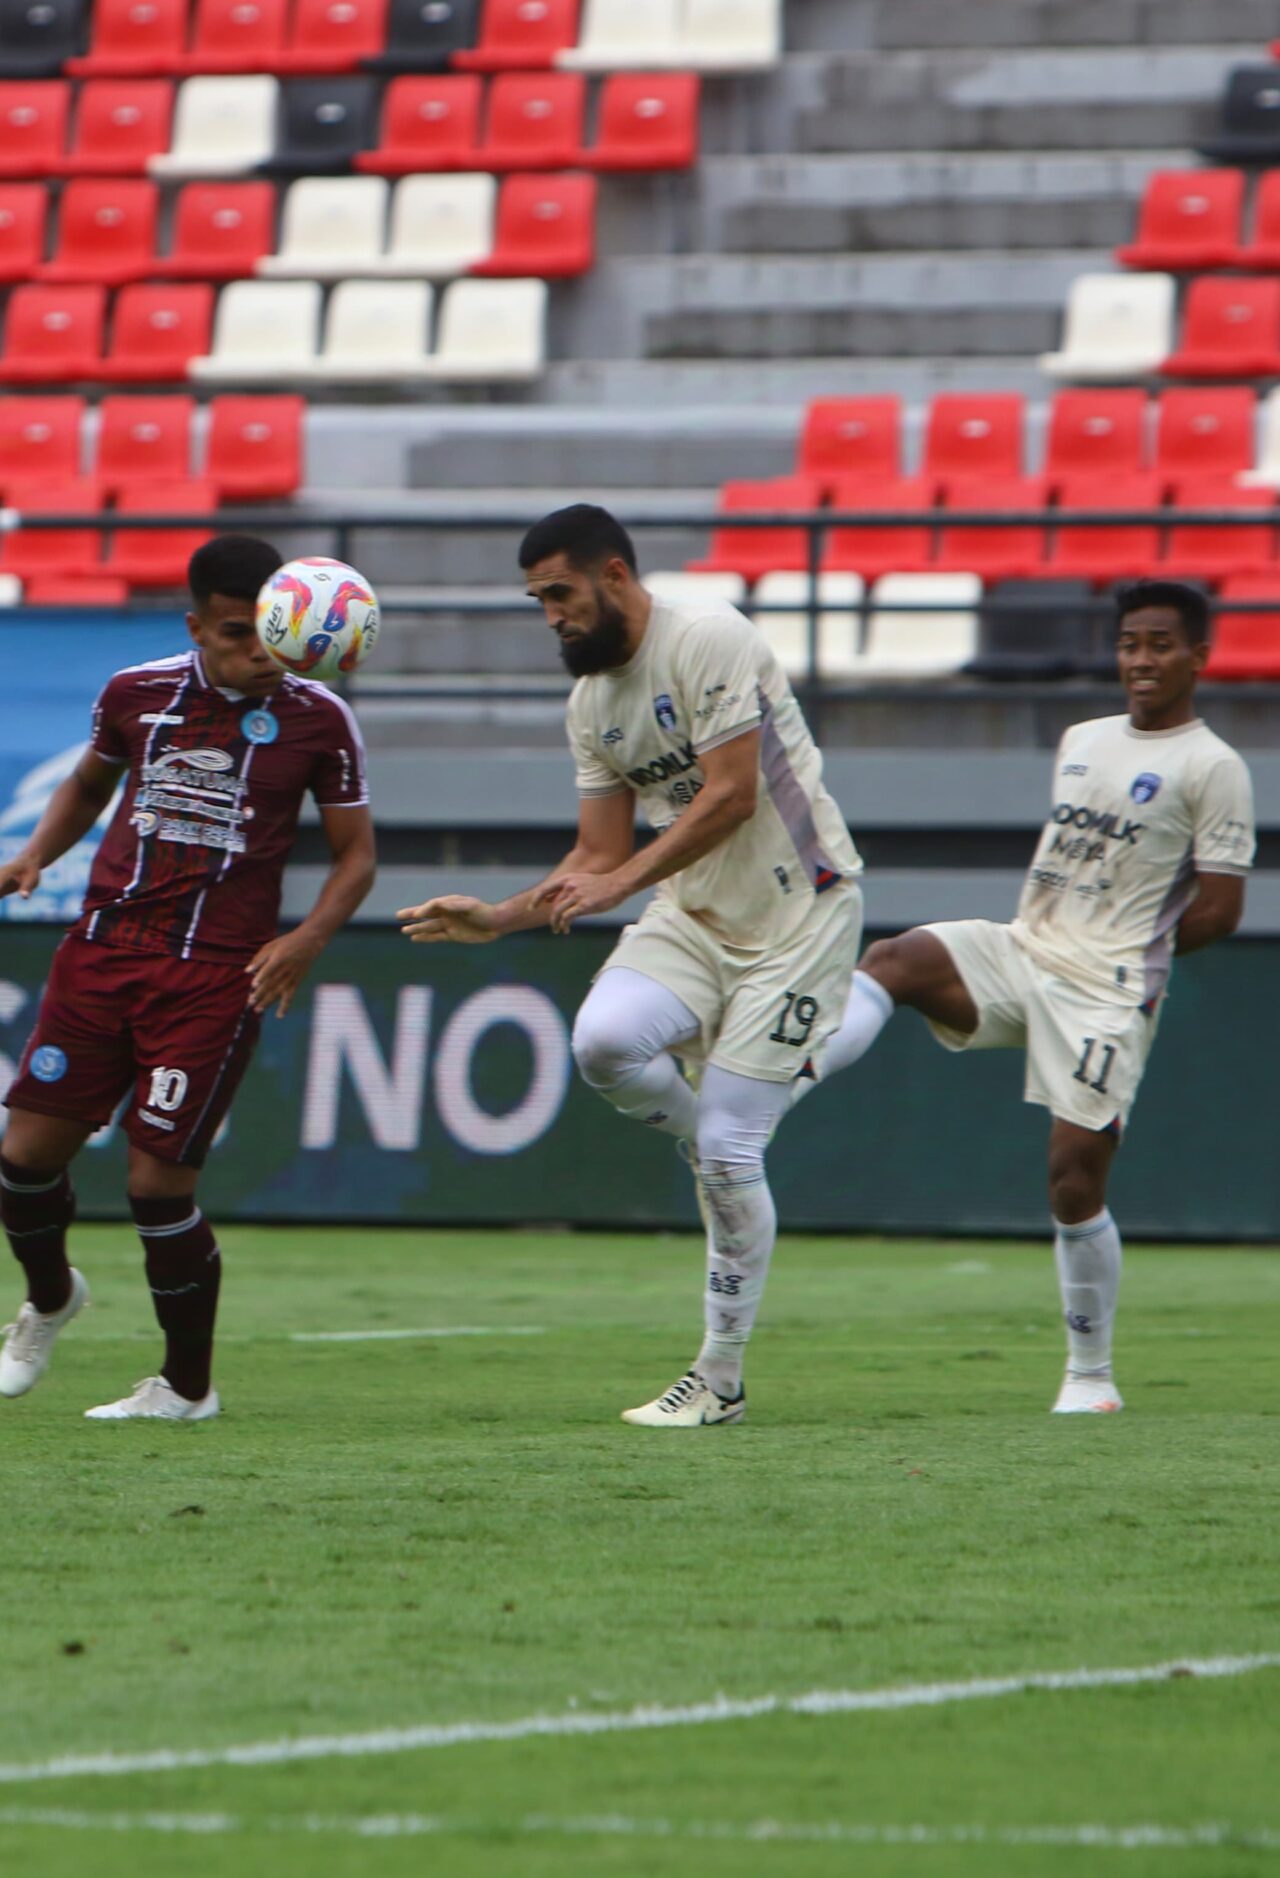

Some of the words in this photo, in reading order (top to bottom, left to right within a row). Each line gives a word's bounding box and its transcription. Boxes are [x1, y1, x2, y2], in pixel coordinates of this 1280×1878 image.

[768, 991, 819, 1047] 19
[147, 1065, 188, 1111] 10
[301, 983, 572, 1155] NO
[1072, 1036, 1117, 1094] 11
